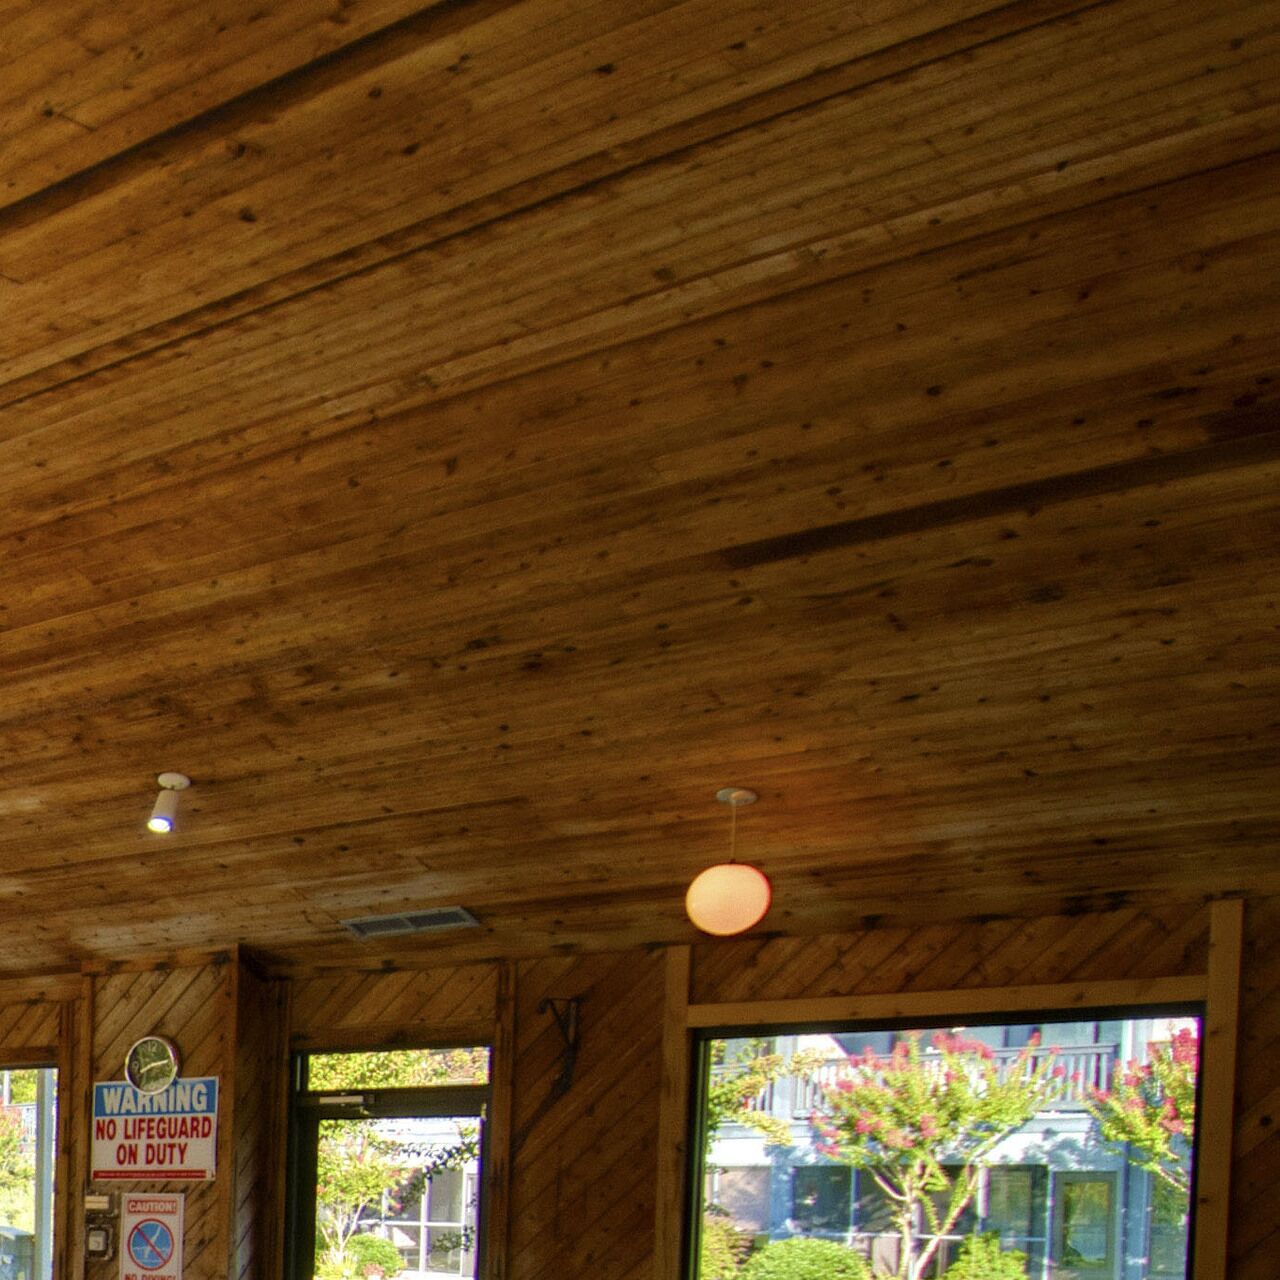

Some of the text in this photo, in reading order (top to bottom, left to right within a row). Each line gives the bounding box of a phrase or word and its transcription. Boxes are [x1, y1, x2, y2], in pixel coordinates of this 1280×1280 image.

[102, 1083, 208, 1114] WARNING
[96, 1116, 212, 1141] NO LIFEGUARD
[116, 1142, 188, 1166] ON DUTY
[129, 1201, 177, 1213] CAUTION!
